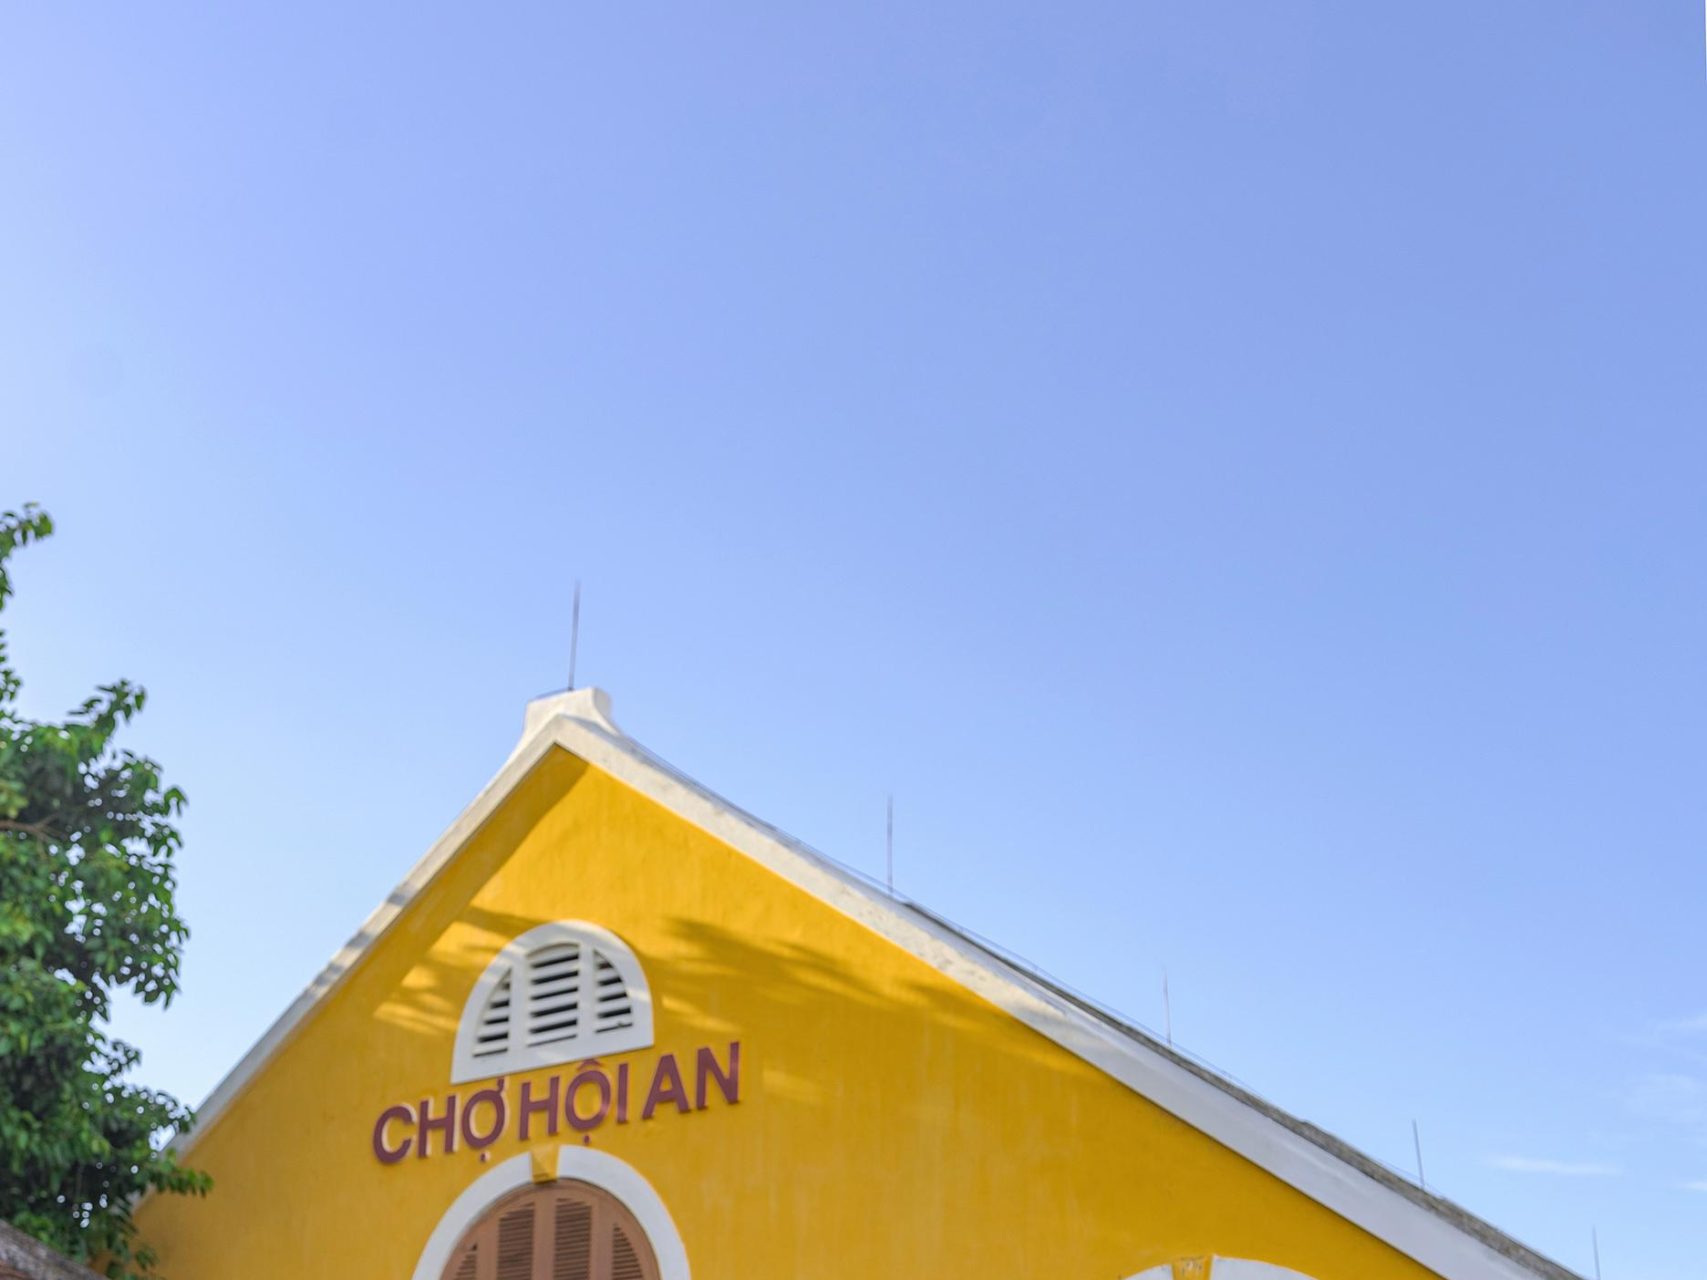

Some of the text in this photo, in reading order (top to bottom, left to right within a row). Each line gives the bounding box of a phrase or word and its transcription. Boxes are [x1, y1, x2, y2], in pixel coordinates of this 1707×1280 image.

[372, 1041, 741, 1164] CHỢ HỘI AN
